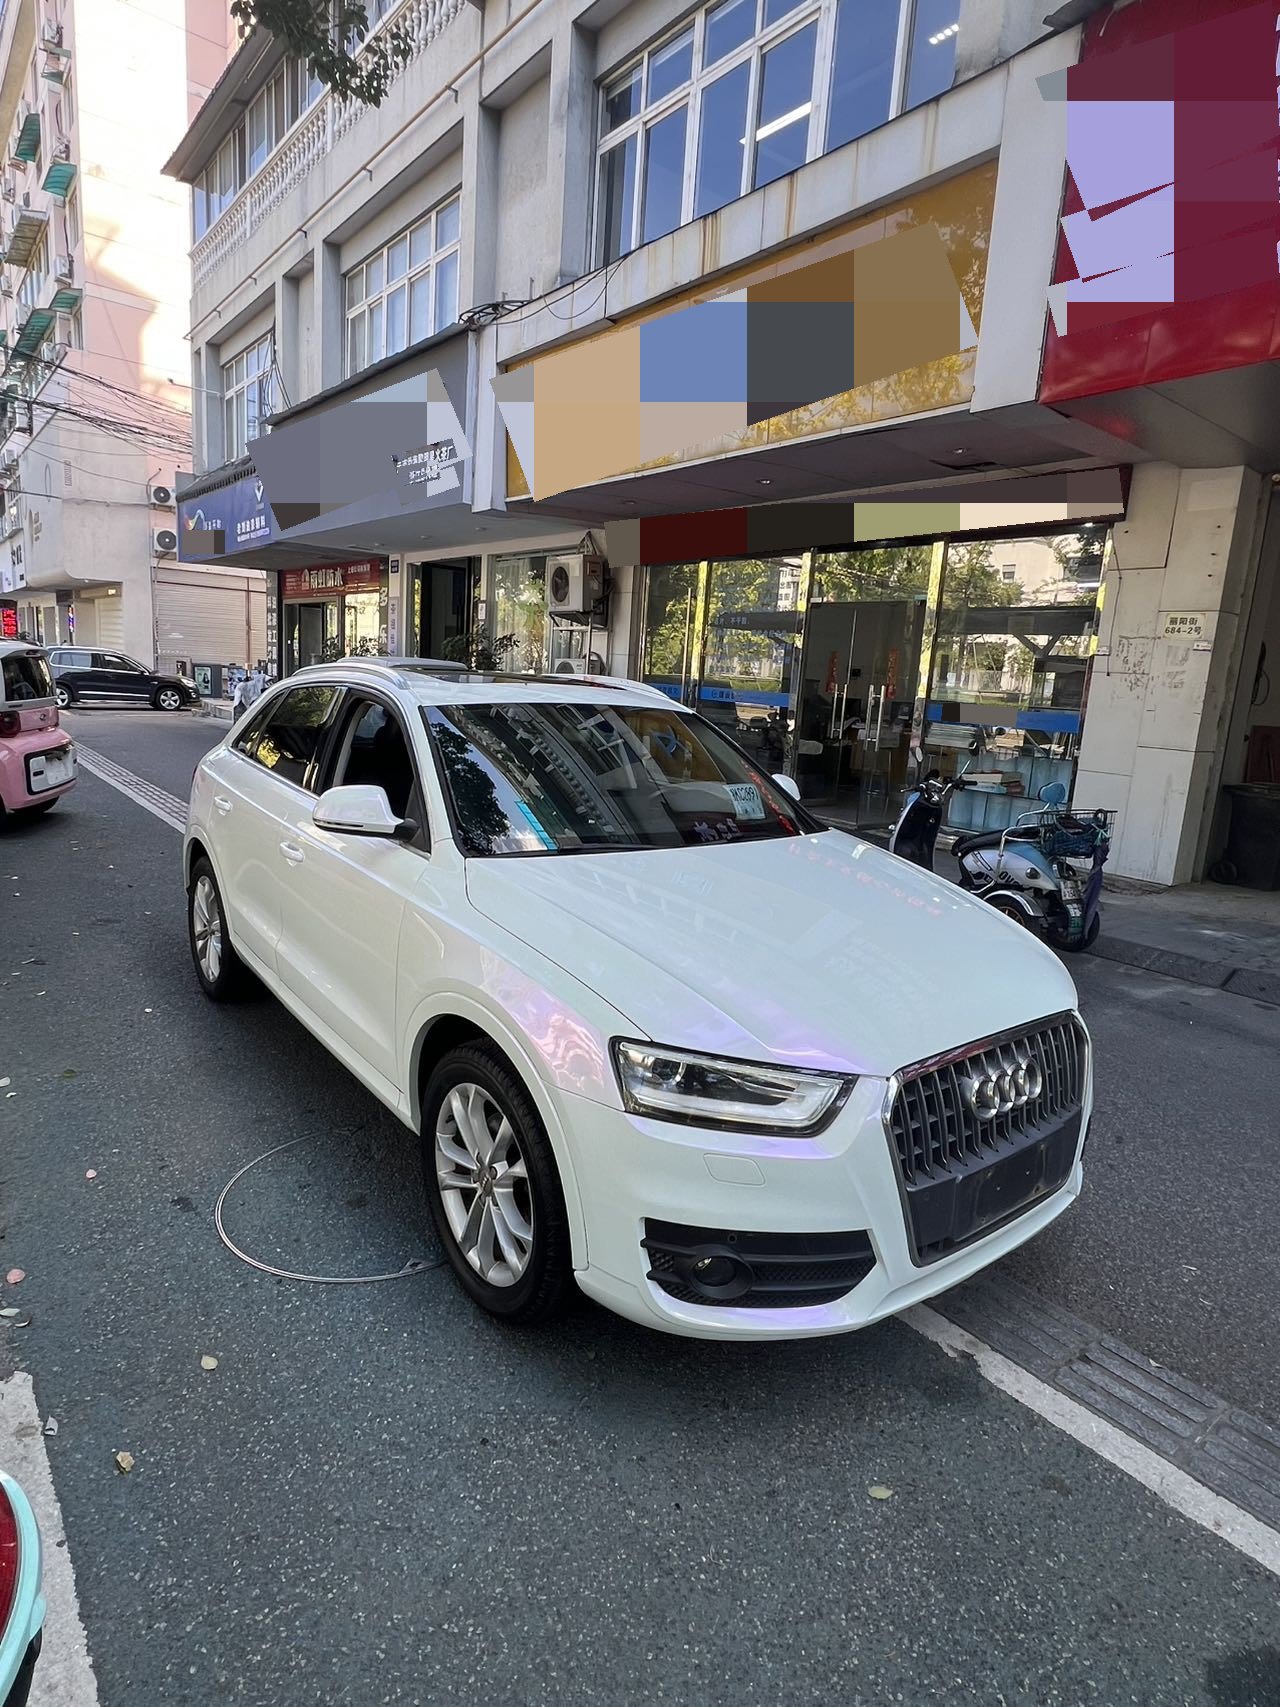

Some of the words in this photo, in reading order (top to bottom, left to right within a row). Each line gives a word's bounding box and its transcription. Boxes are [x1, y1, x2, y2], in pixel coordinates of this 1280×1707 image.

[1169, 617, 1198, 626] 丽阳街
[1164, 626, 1202, 635] 684-2号
